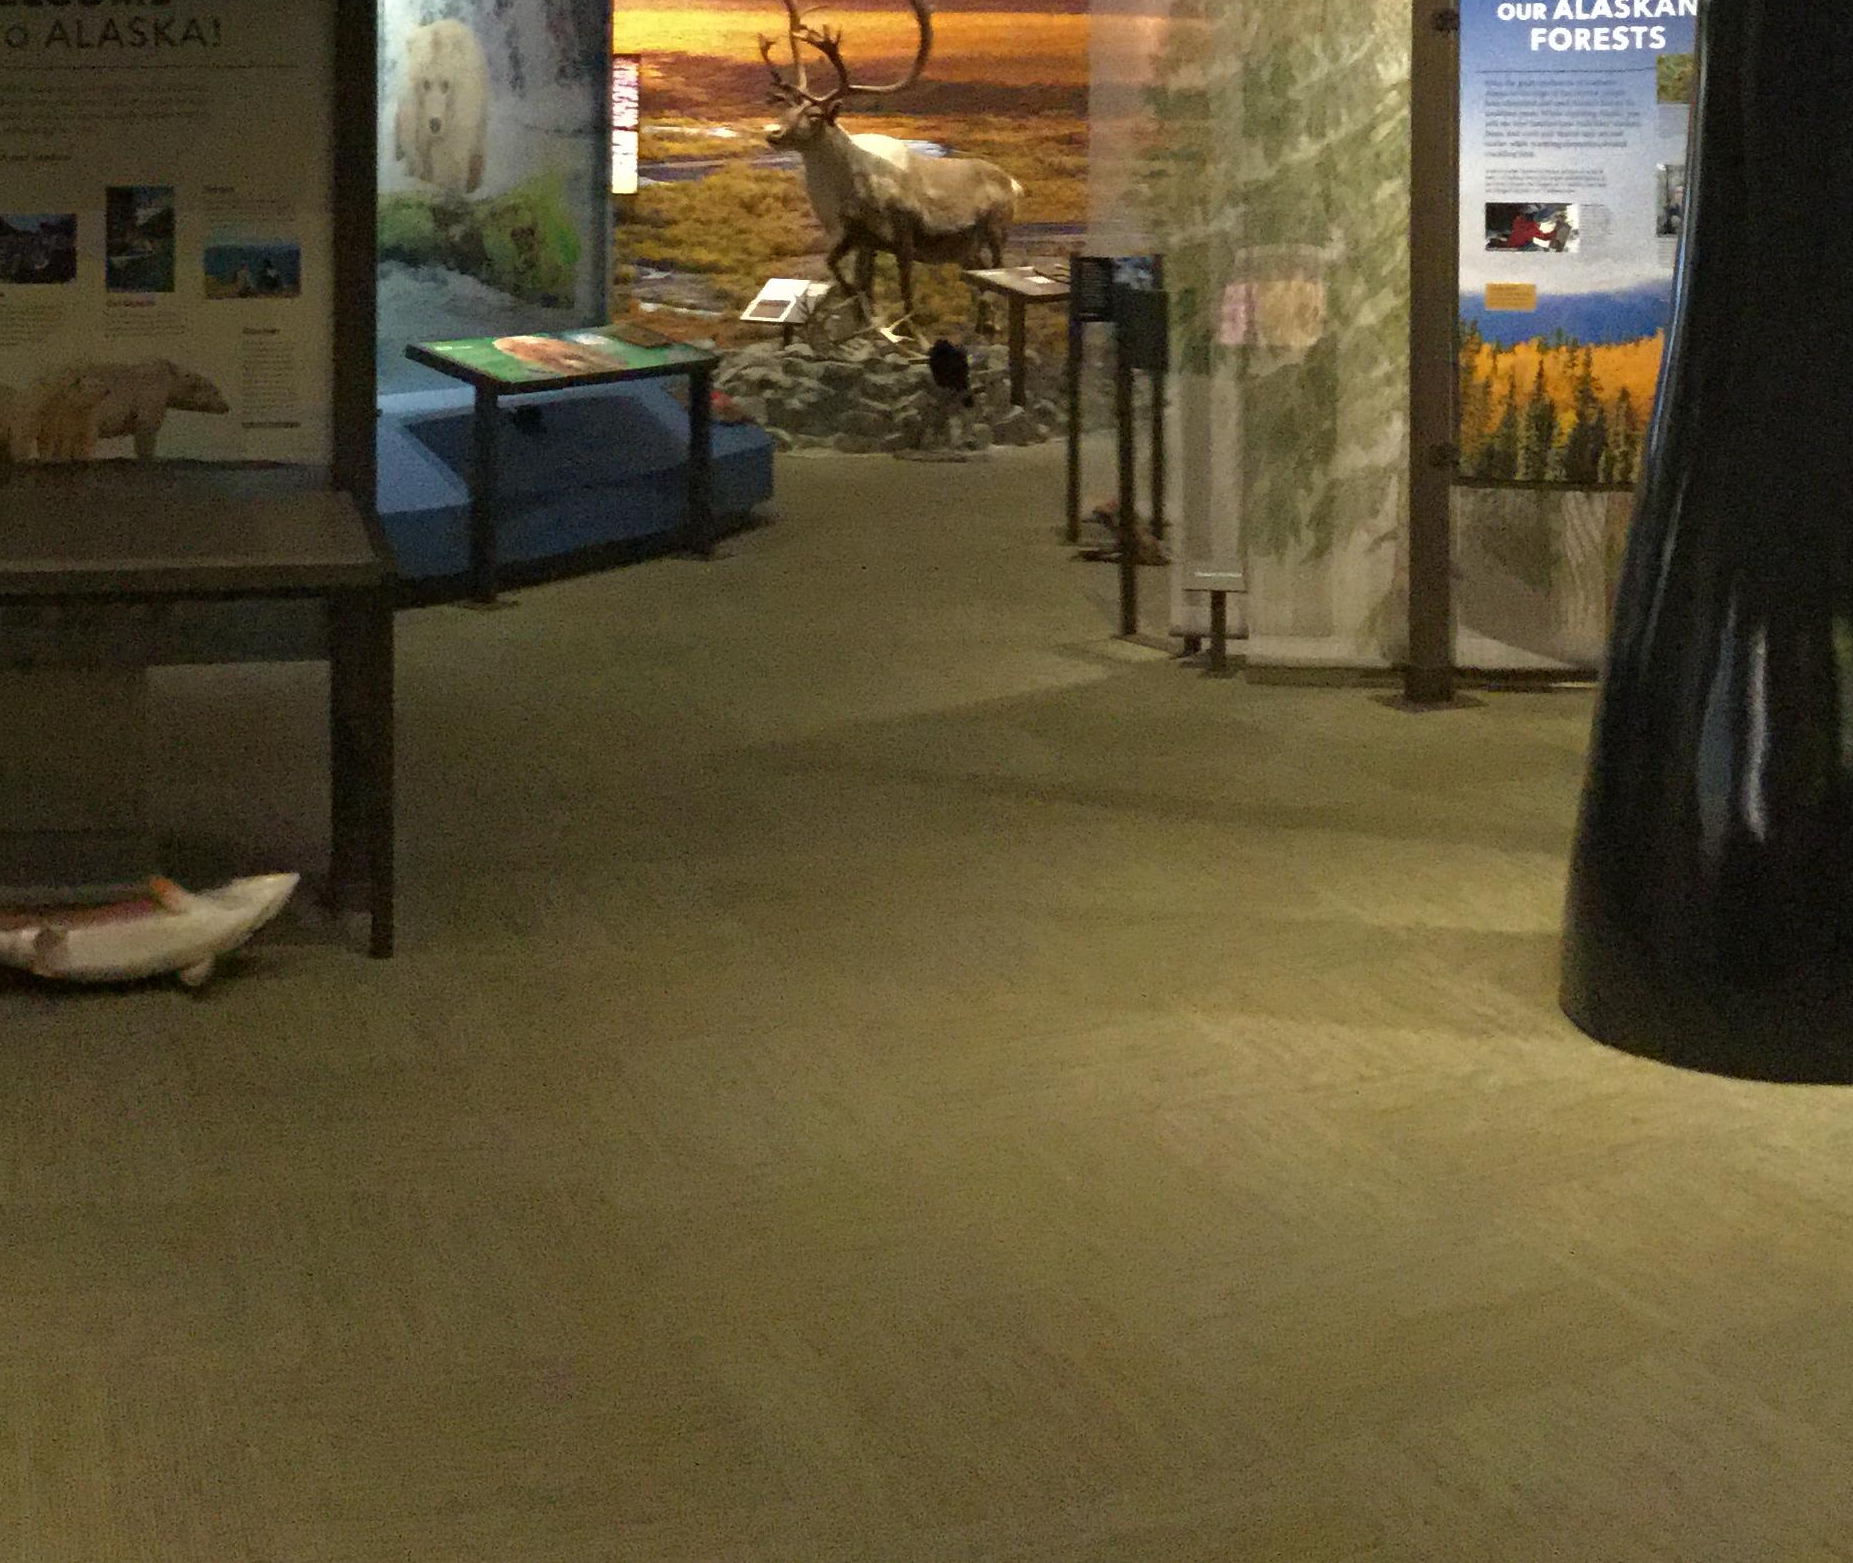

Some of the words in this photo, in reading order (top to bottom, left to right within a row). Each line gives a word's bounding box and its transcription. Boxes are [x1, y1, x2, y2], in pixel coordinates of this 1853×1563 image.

[1497, 2, 1547, 21] OUR
[45, 16, 222, 49] ALASKA!
[1530, 25, 1666, 52] FORESTS
